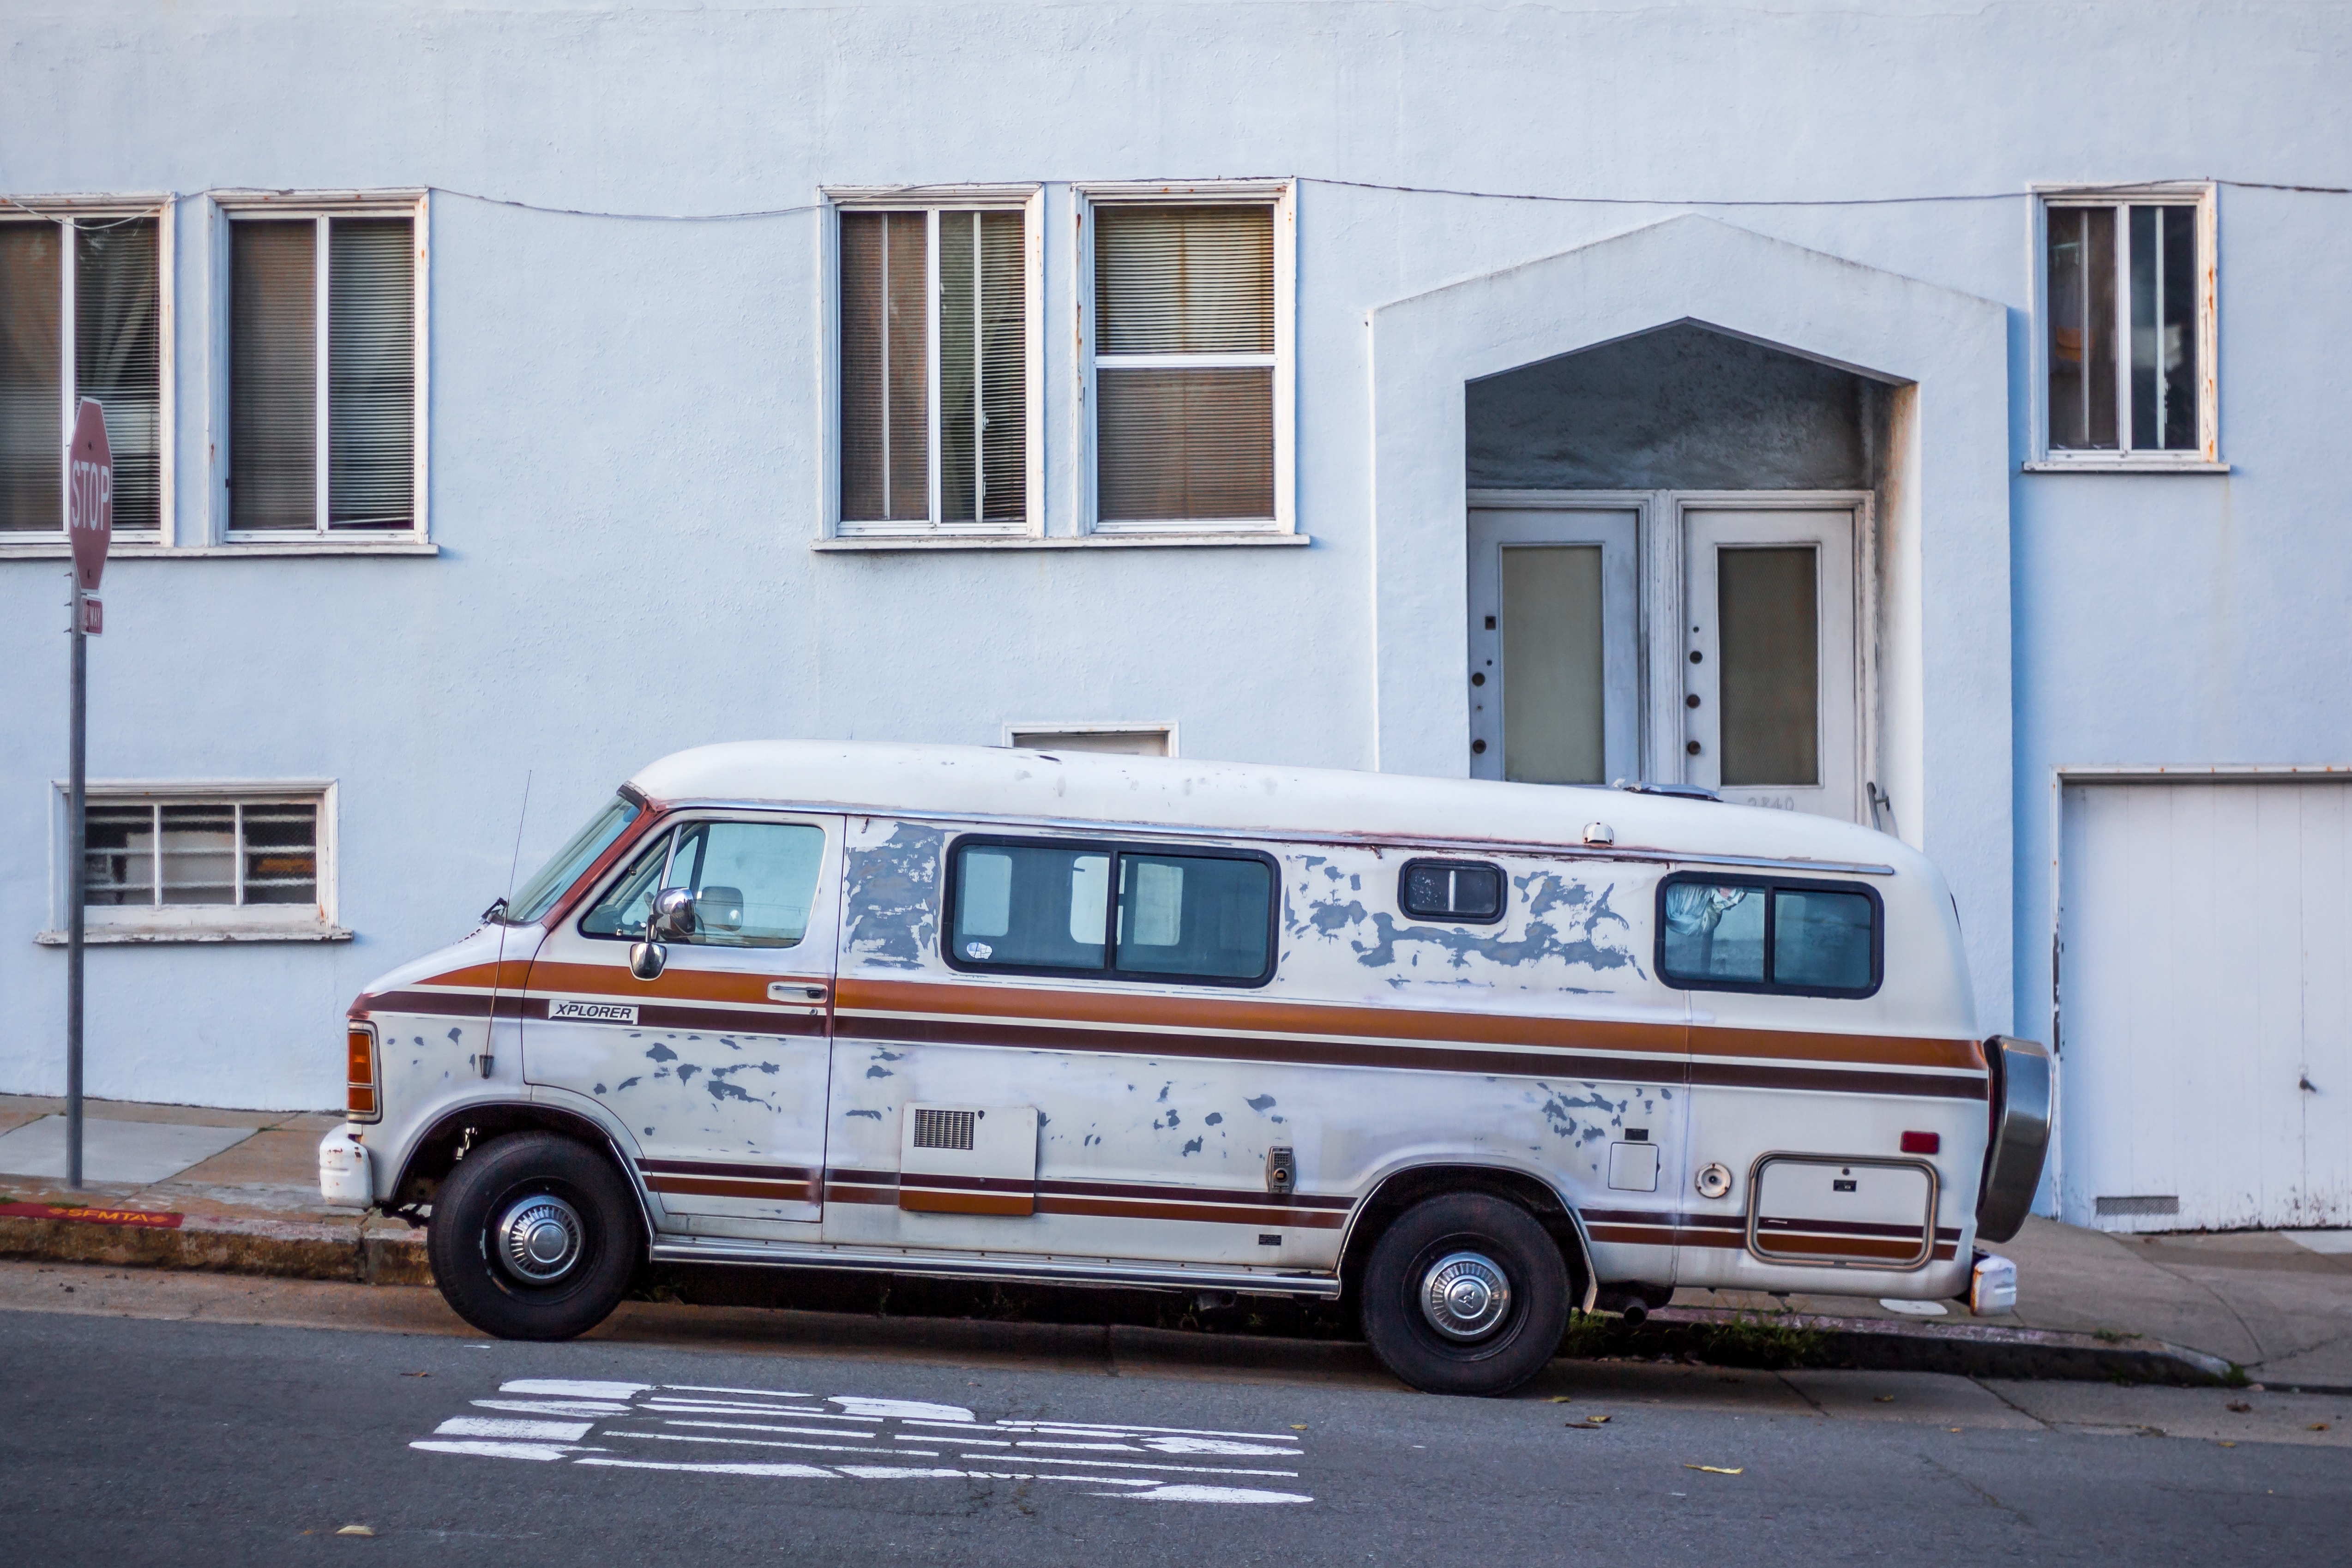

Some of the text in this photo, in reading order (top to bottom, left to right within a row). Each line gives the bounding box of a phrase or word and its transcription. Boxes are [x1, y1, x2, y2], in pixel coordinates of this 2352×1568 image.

[72, 459, 110, 531] STOP
[90, 607, 100, 628] WAY
[555, 1004, 632, 1019] XPLORER
[67, 1208, 148, 1222] SFMTA
[409, 1379, 1315, 1504] STOP
